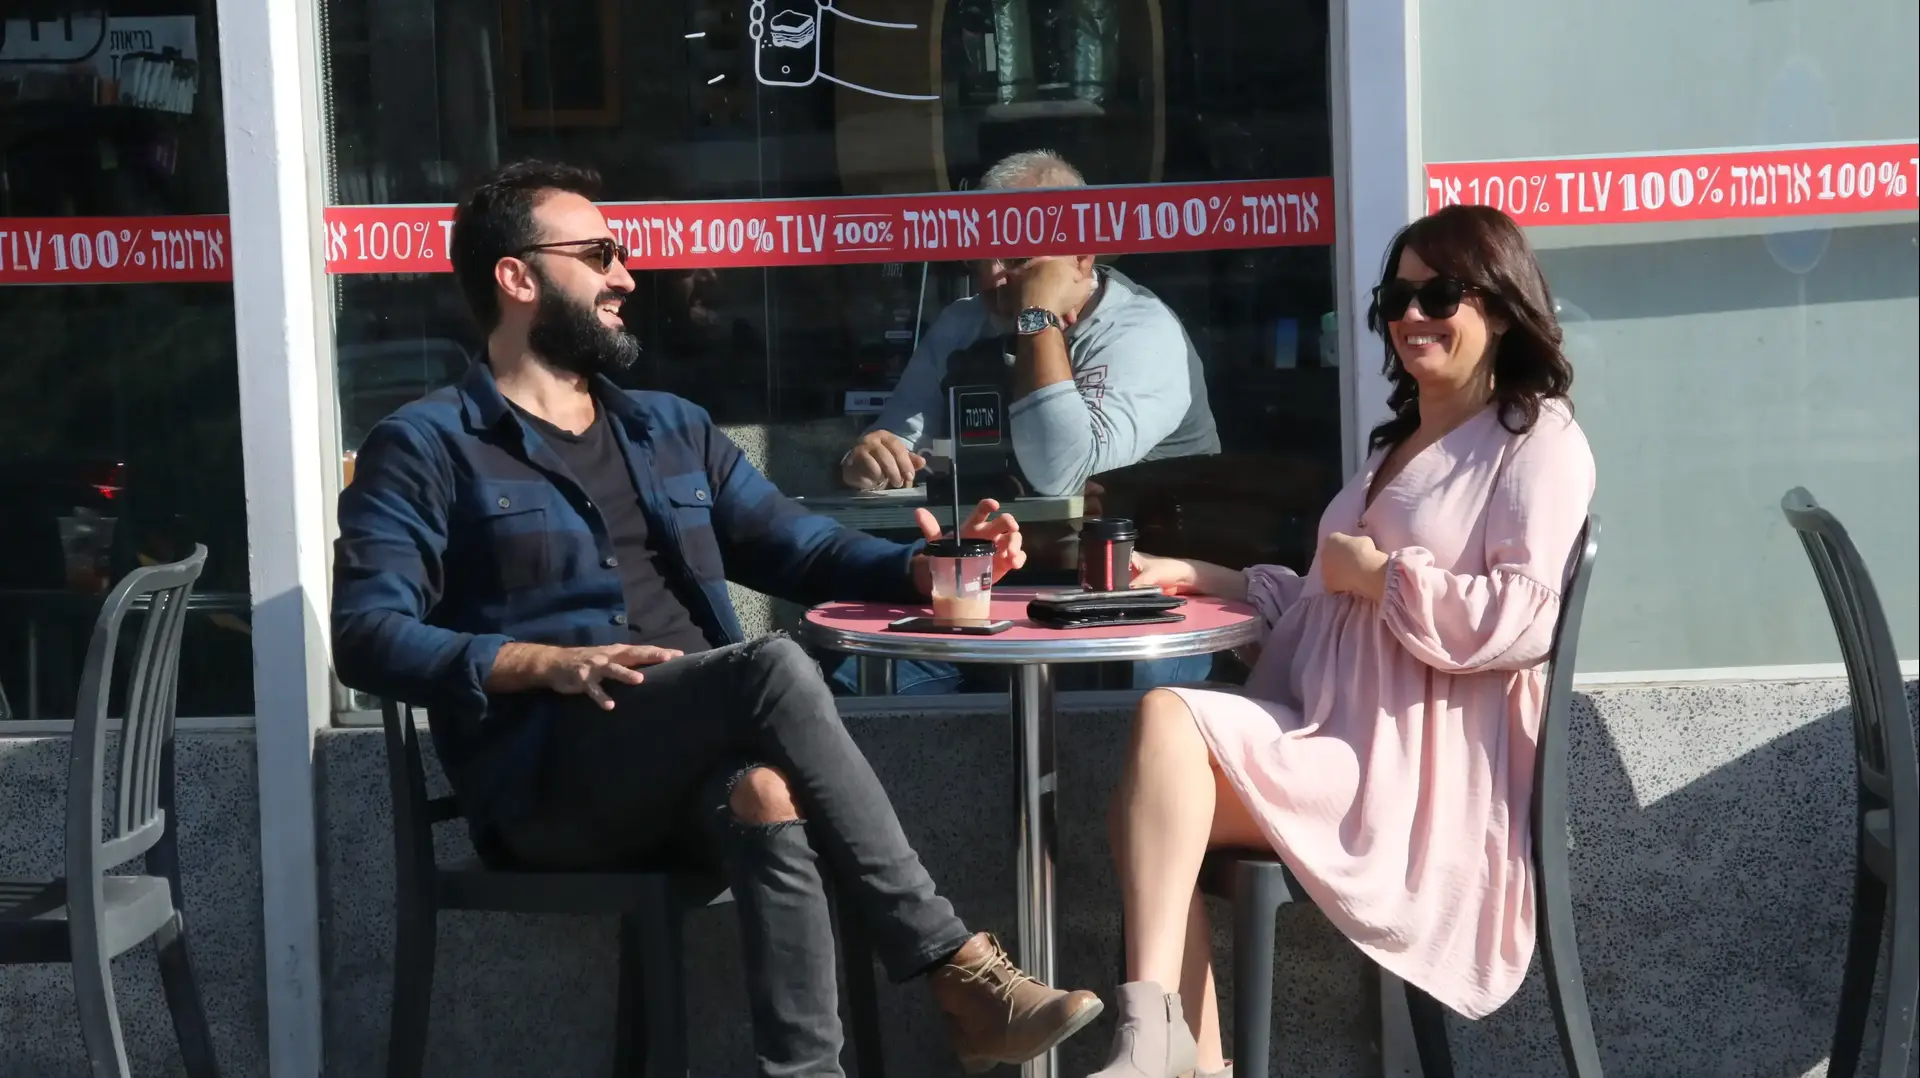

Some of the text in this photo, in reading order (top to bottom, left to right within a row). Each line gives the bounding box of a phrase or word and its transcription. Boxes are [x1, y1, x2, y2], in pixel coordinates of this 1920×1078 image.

[110, 30, 154, 50] בריאות
[1468, 174, 1550, 214] 100%
[1555, 170, 1613, 214] TLV
[1618, 166, 1724, 212] 100%
[1730, 162, 1812, 207] ארומה
[1817, 161, 1908, 200] 100%
[353, 221, 434, 260] 100%
[689, 217, 774, 254] 100%
[775, 214, 827, 253] TLV
[832, 221, 894, 245] 100%
[903, 207, 980, 250] ארומה
[986, 205, 1067, 246] 100%
[1071, 201, 1127, 243] TLV
[1132, 195, 1236, 241] 100%
[1242, 192, 1319, 236] ארומה
[48, 230, 146, 271] 100%
[151, 229, 224, 270] ארומה
[965, 407, 995, 427] ארומה
